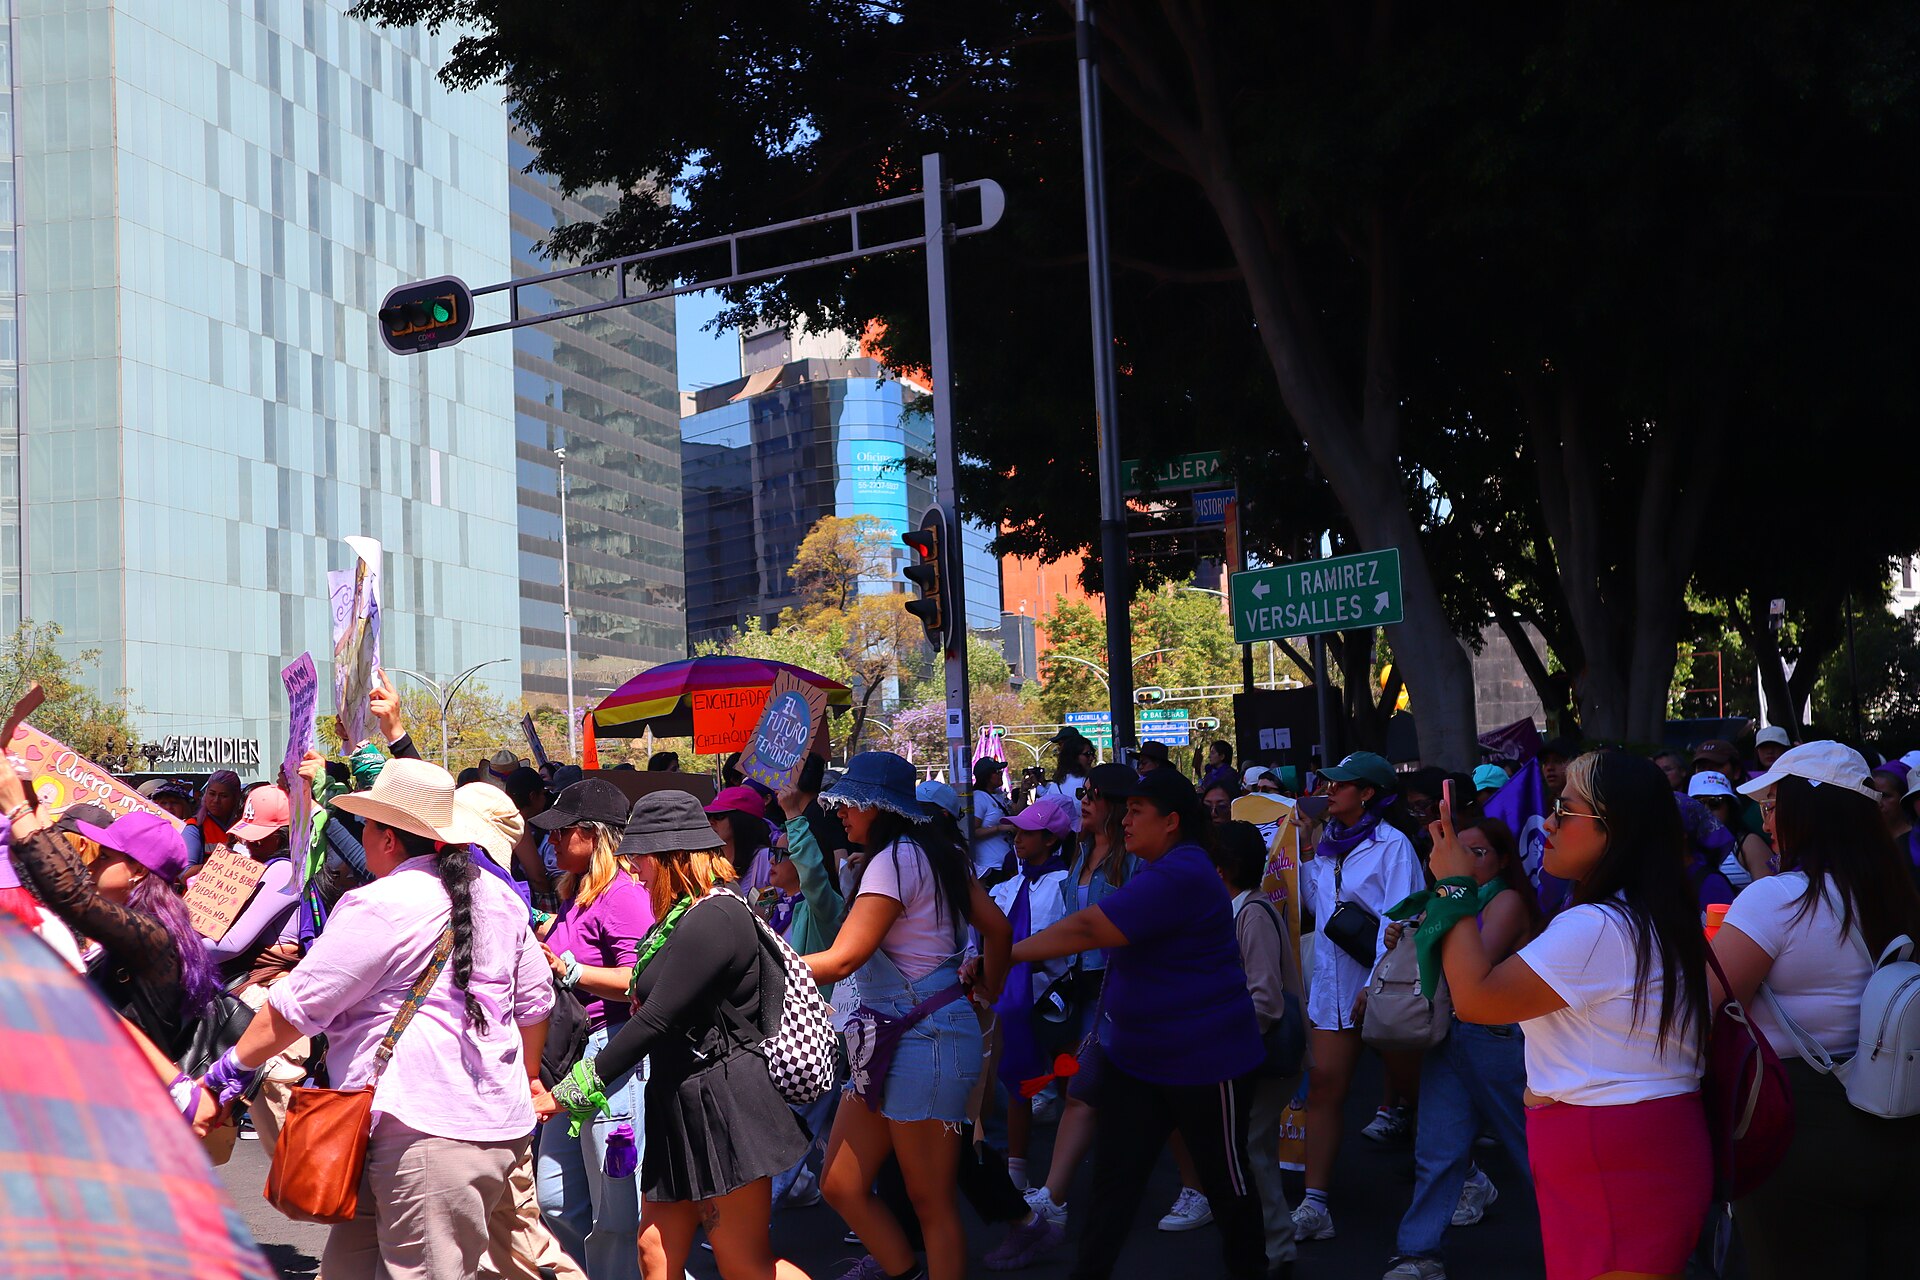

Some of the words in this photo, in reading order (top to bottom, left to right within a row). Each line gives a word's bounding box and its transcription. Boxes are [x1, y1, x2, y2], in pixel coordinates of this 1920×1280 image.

[1130, 458, 1221, 485] LDERA
[1287, 574, 1292, 598] I
[1300, 560, 1380, 596] RAMIREZ
[1245, 594, 1363, 633] VERSALLES
[782, 696, 797, 718] EL
[1150, 711, 1185, 719] BALDERAS
[766, 710, 808, 745] FUTURO
[773, 732, 788, 749] ES
[179, 736, 260, 764] MERIDIEN
[755, 734, 801, 768] FEMINISTA
[56, 751, 113, 799] Quiero
[205, 859, 225, 875] POR
[224, 868, 240, 880] LAS
[214, 845, 230, 860] HOY
[231, 855, 258, 874] VENGO
[191, 882, 218, 900] PUEDEN
[199, 871, 216, 884] QUE
[224, 885, 237, 895] NO
